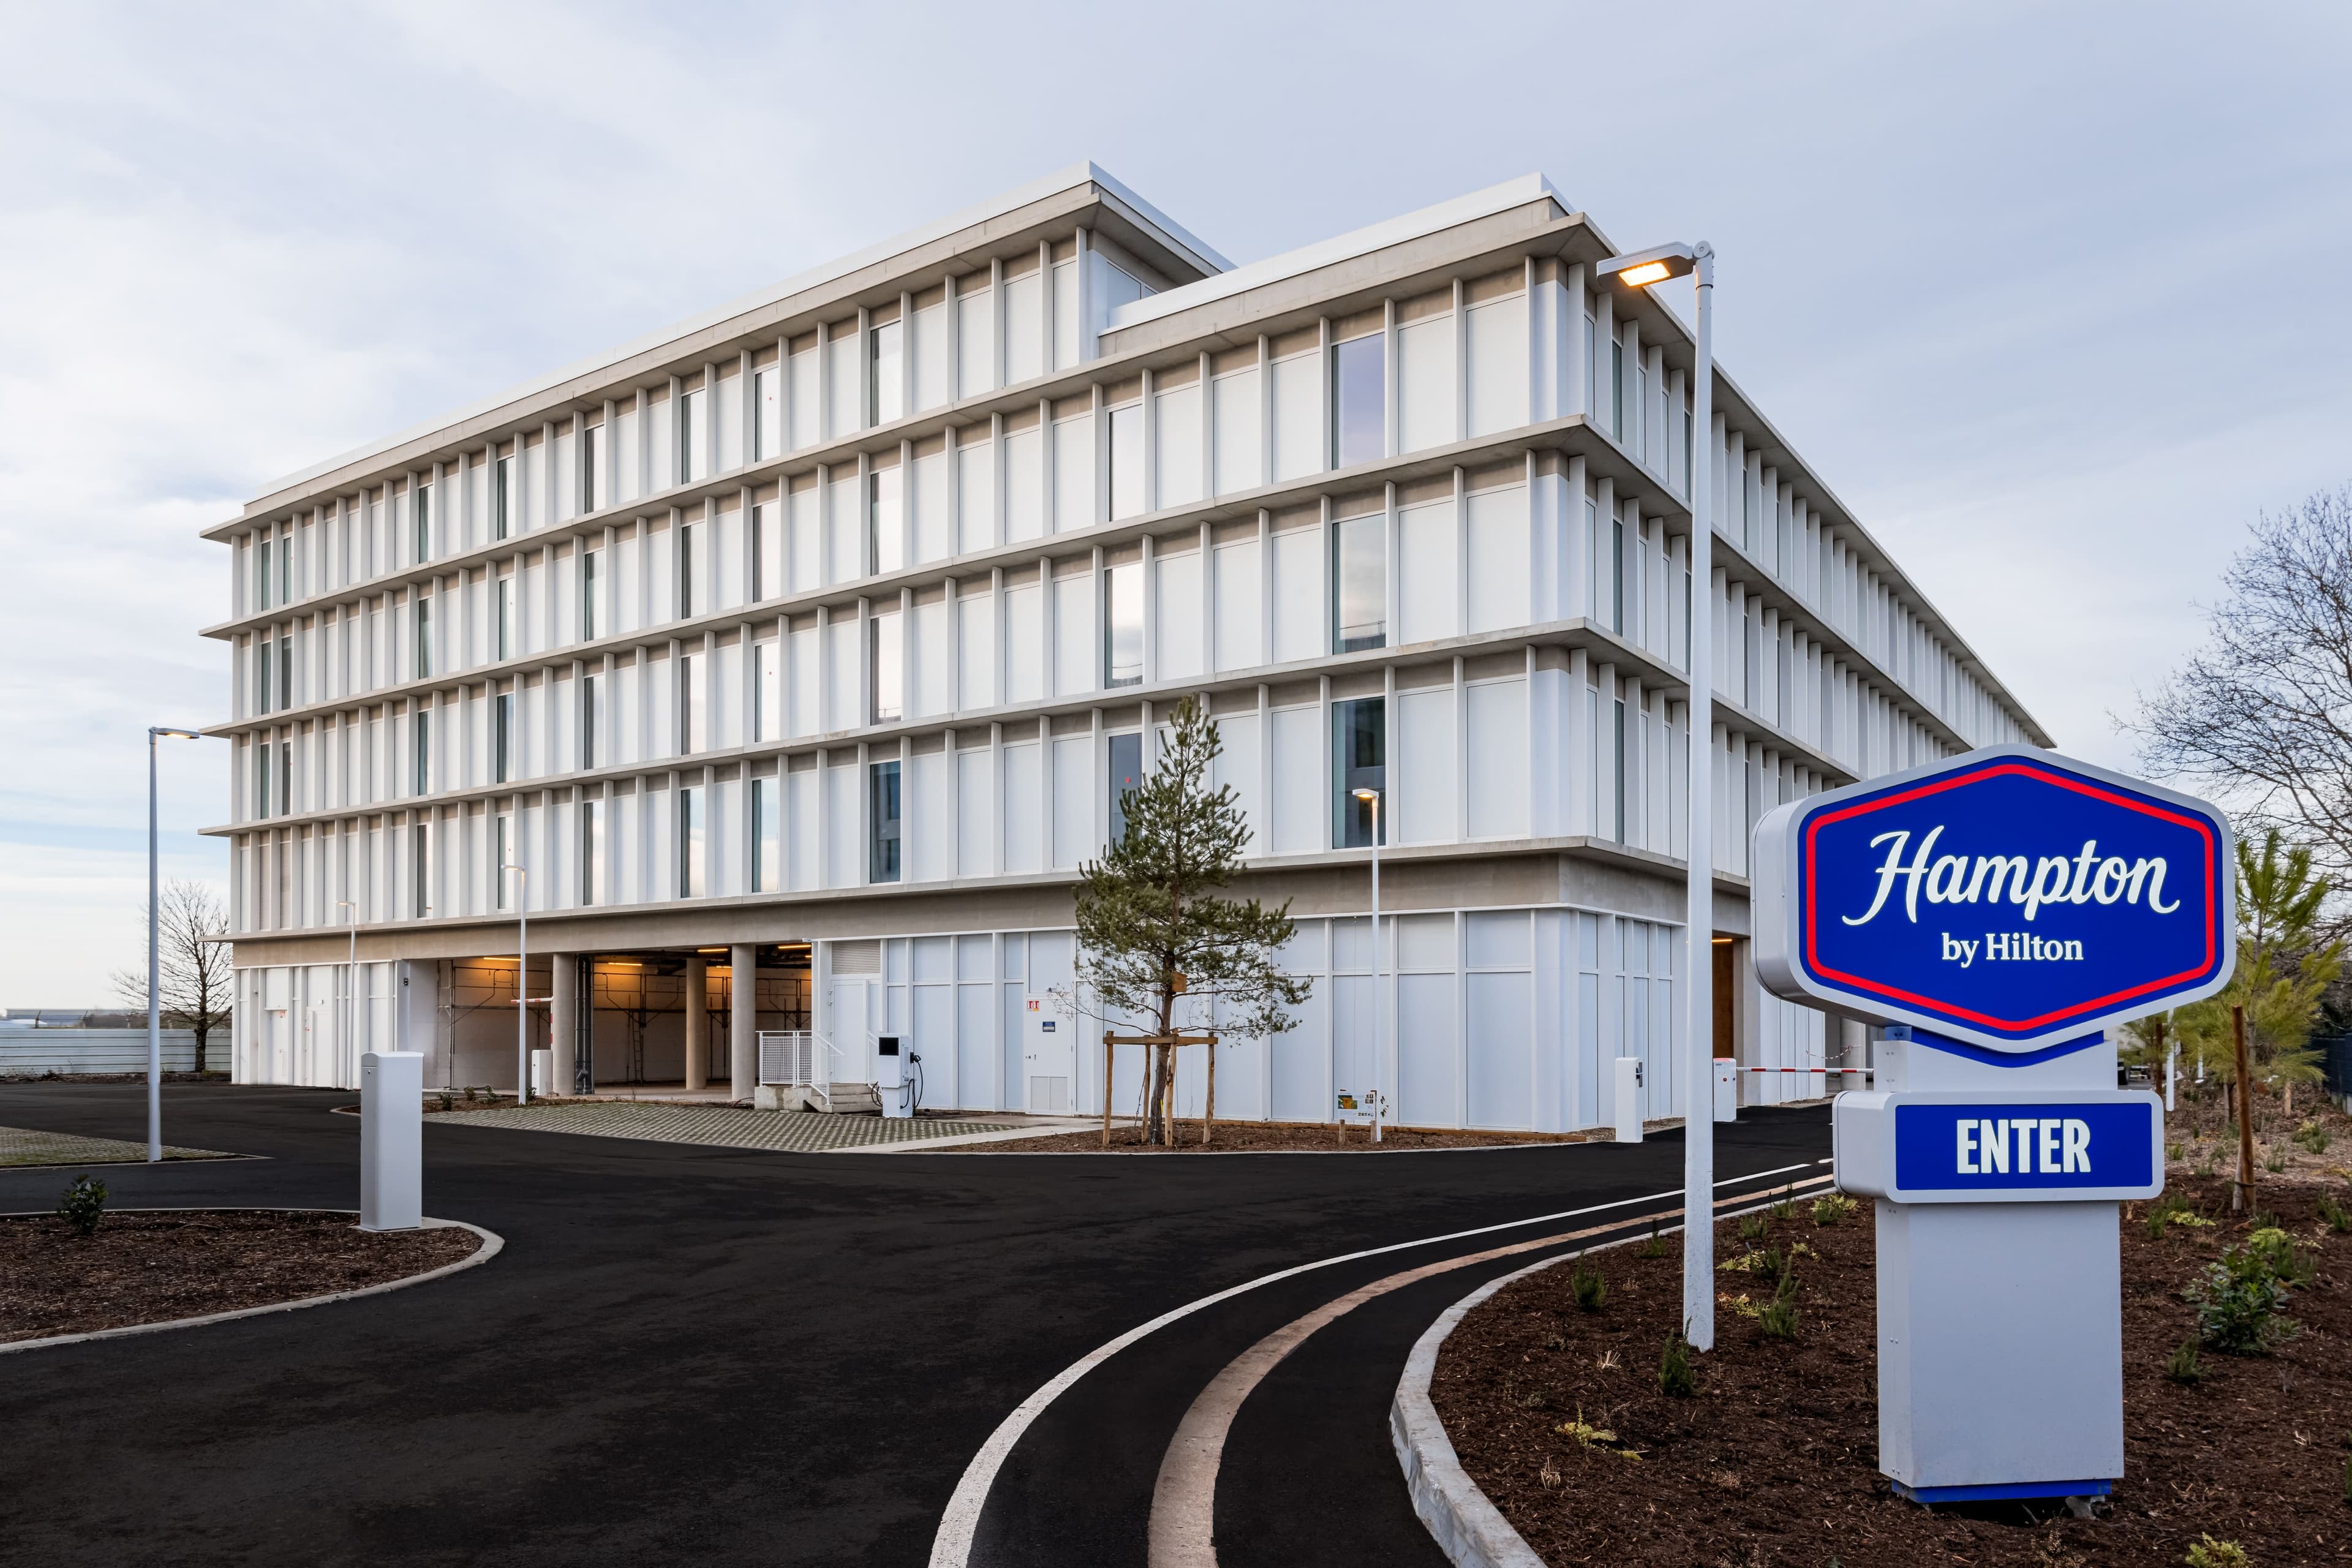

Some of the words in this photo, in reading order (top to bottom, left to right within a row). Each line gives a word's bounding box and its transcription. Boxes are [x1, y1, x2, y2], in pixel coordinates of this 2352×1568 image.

[1842, 825, 2180, 925] Hampton
[1942, 932, 1980, 968] by
[1985, 932, 2084, 961] Hilton
[1957, 1119, 2091, 1174] ENTER
